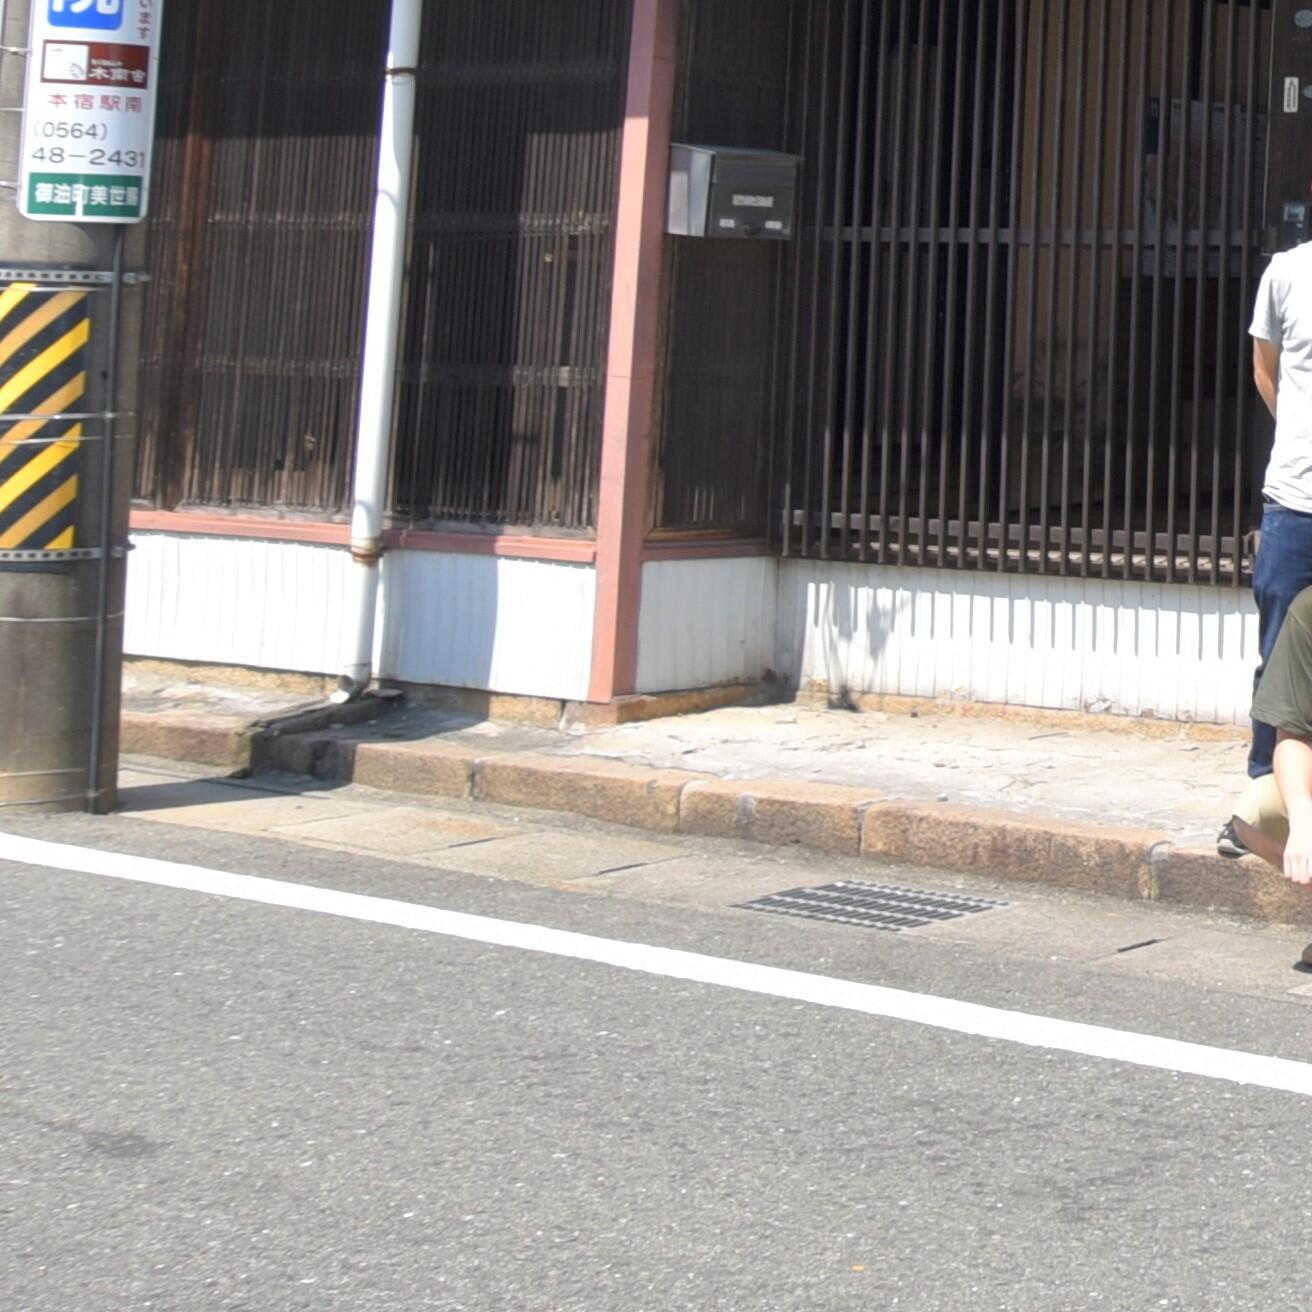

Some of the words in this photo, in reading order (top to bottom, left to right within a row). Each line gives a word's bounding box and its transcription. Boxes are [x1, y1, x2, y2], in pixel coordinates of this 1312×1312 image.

[48, 93, 143, 114] 本宿駅南
[34, 121, 108, 141] (0564)
